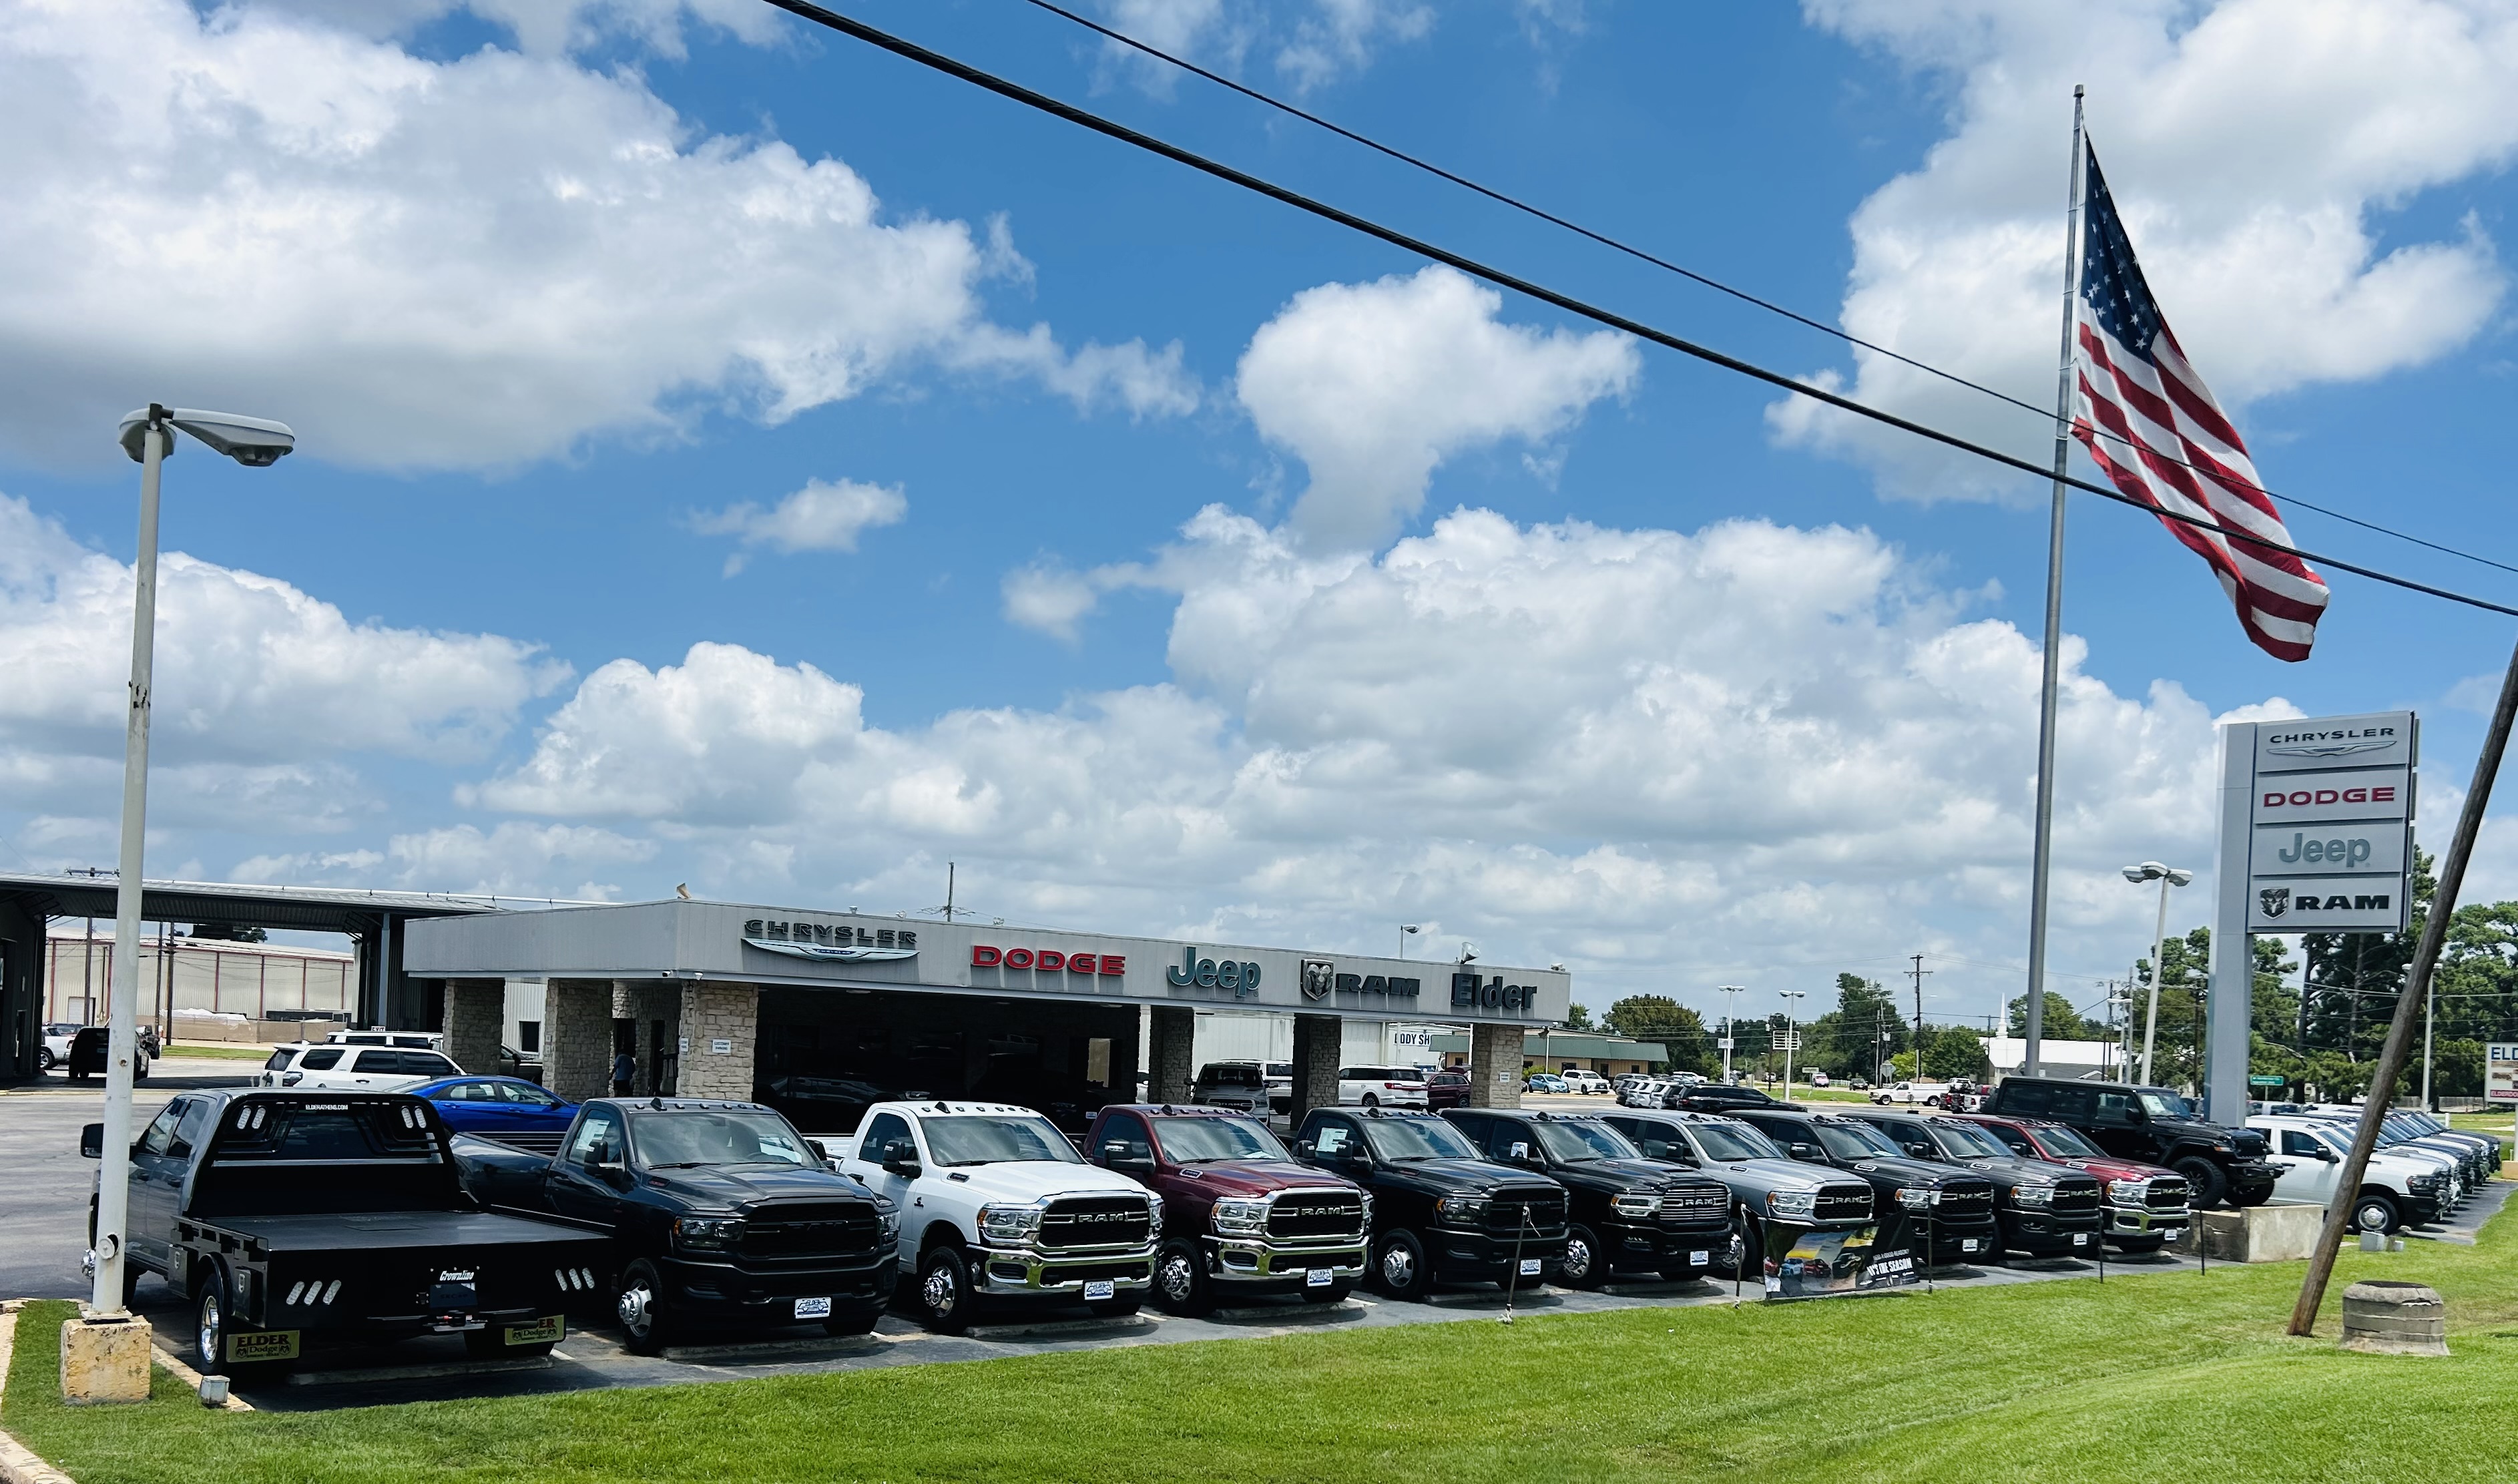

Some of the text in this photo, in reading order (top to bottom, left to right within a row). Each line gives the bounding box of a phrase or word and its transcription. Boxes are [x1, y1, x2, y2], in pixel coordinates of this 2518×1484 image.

[2270, 728, 2394, 743] CHRYSLER
[2264, 787, 2395, 807] DODGE
[2278, 832, 2370, 867] Jeep
[2295, 895, 2390, 910] RAM
[744, 919, 918, 943] CHRYSLER
[971, 945, 1126, 975] DODGE
[1166, 947, 1262, 997] Jeep
[1336, 973, 1421, 996] RAM
[1451, 973, 1537, 1011] Elder
[1078, 1214, 1123, 1223] RAM
[1301, 1207, 1340, 1216] RAM
[1888, 1257, 1913, 1272] SEASON
[523, 1329, 546, 1337] Dodge
[237, 1334, 290, 1348] ELDER
[250, 1346, 278, 1354] Dodge
